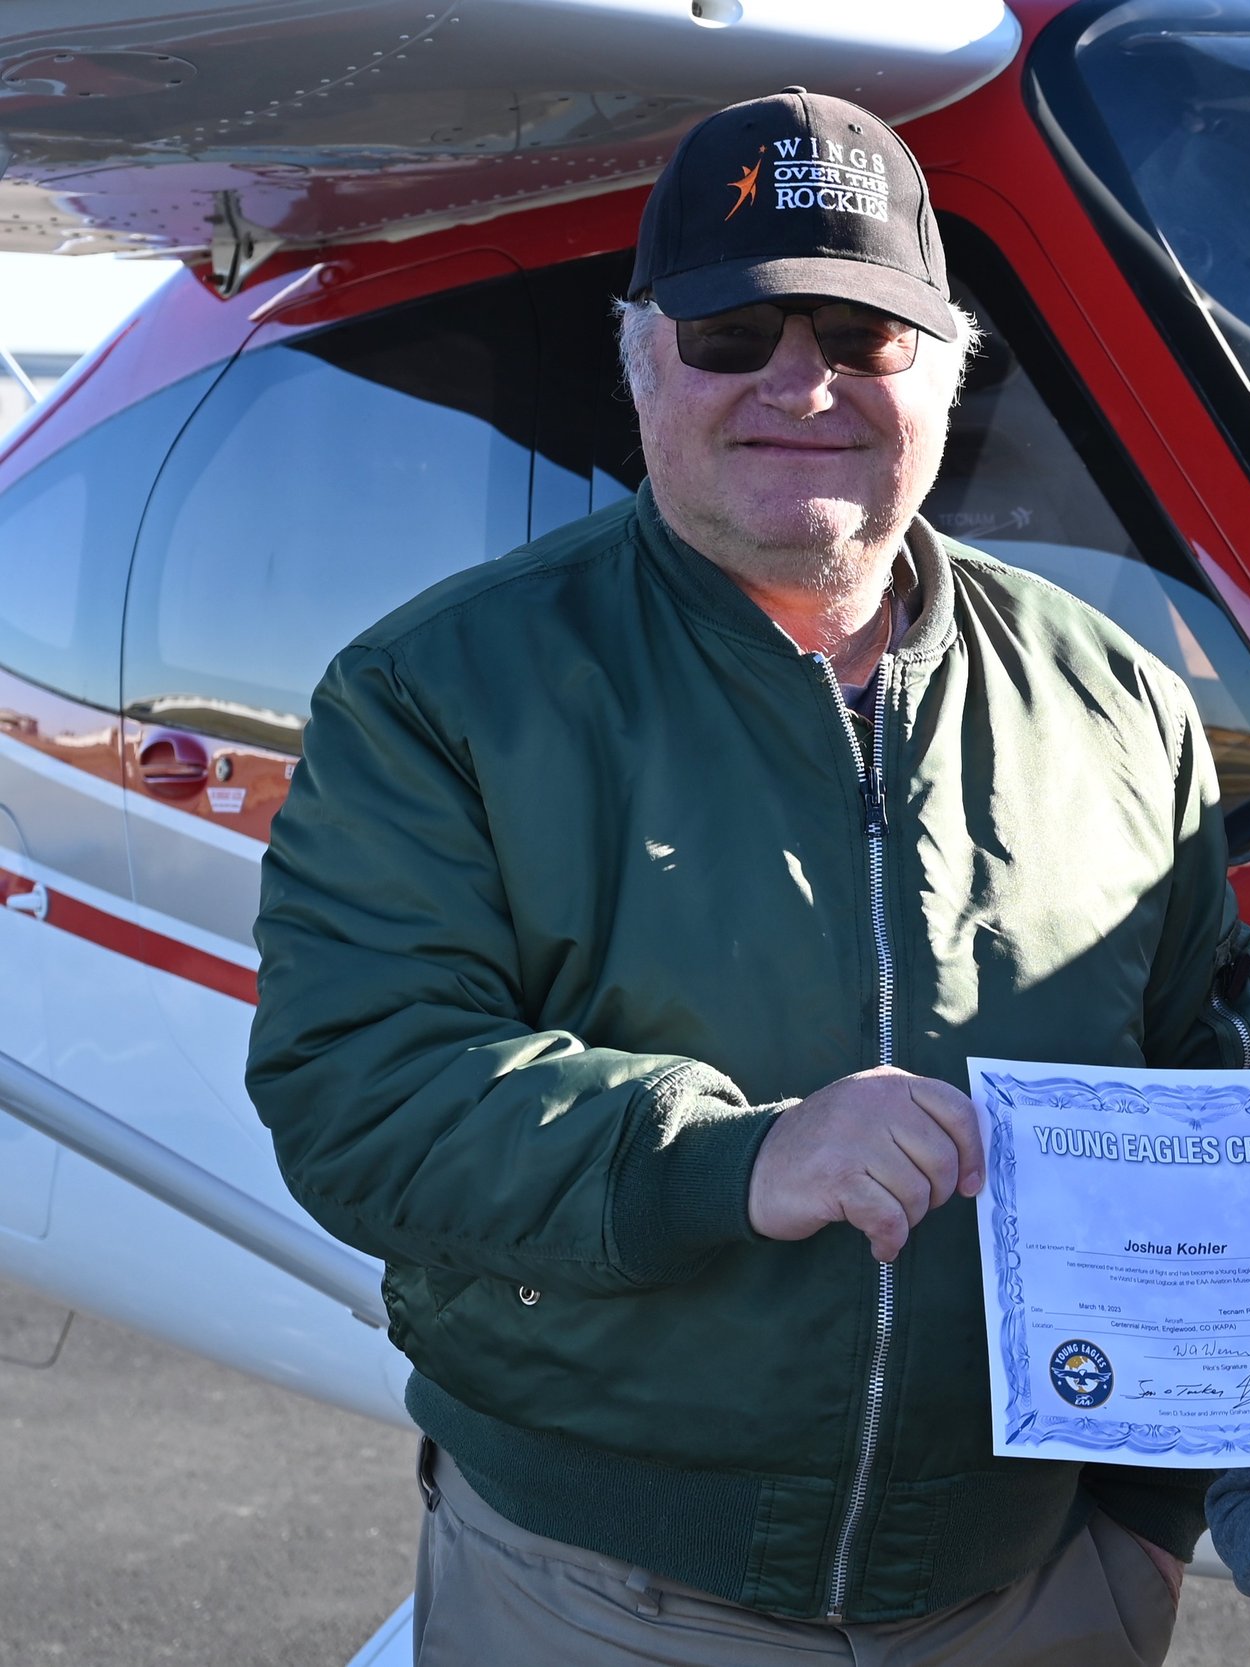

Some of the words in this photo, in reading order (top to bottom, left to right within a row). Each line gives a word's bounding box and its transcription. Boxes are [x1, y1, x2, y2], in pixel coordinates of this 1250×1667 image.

[774, 137, 885, 173] WINGS
[774, 166, 841, 183] OVER
[846, 172, 889, 195] THE
[776, 188, 888, 222] ROCKIES
[938, 512, 996, 527] TECNAM
[1033, 1125, 1118, 1161] YOUNG
[1123, 1132, 1220, 1164] EAGLES
[1124, 1240, 1172, 1255] Joshua
[1177, 1243, 1228, 1255] Kohler
[1077, 1262, 1105, 1270] experienced
[1125, 1266, 1149, 1274] adventure
[1219, 1268, 1237, 1276] Young
[1137, 1277, 1155, 1285] Largest
[1156, 1279, 1178, 1287] Logbook
[1107, 1305, 1122, 1313] 2023
[1110, 1320, 1140, 1329] Centennial
[1213, 1323, 1237, 1331] (KAPA)
[1054, 1343, 1079, 1365] YOUNG
[1081, 1344, 1107, 1369] EAGLES
[1209, 1409, 1228, 1417] Jimmy
